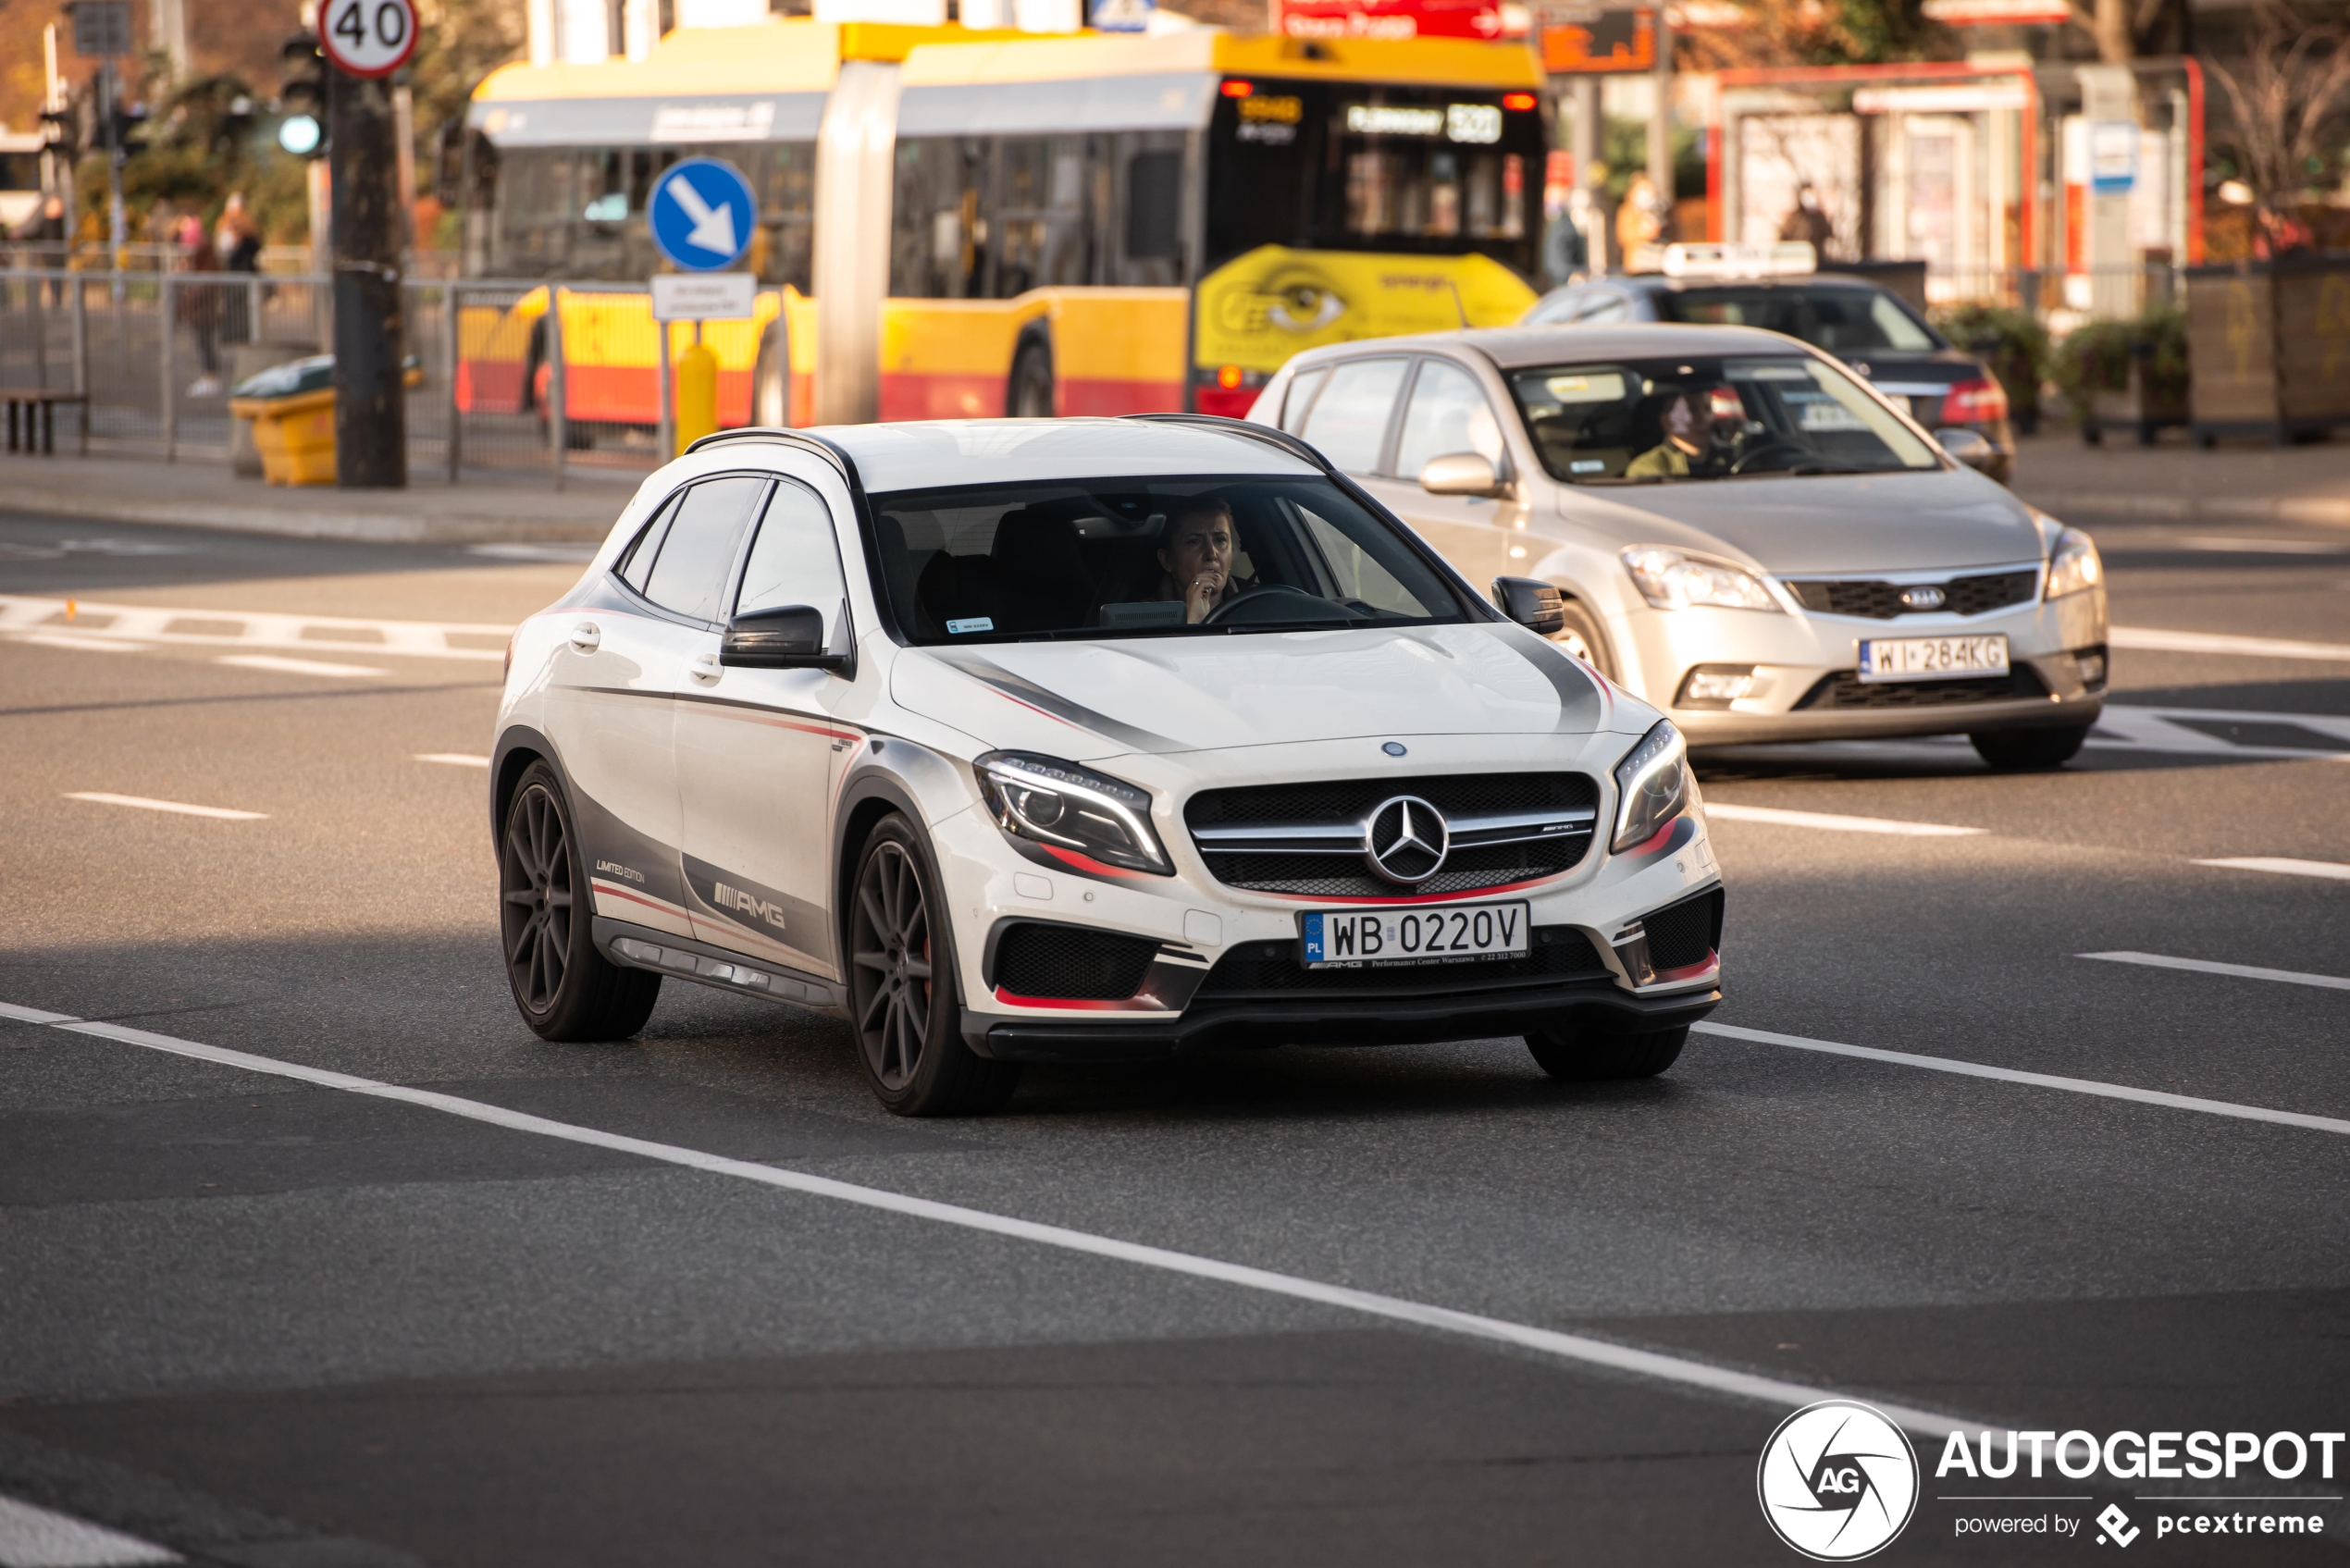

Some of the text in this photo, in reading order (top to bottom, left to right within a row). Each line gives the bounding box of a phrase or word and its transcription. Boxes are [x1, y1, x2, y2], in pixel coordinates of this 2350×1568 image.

[336, 1, 404, 48] 40
[1879, 644, 1907, 670] WI
[1923, 638, 2000, 669] 284KG
[597, 859, 645, 883] LIMITED EDITION
[1333, 908, 1517, 956] WB 0220V
[1307, 943, 1321, 953] PL
[1441, 956, 1475, 964] Warszawa
